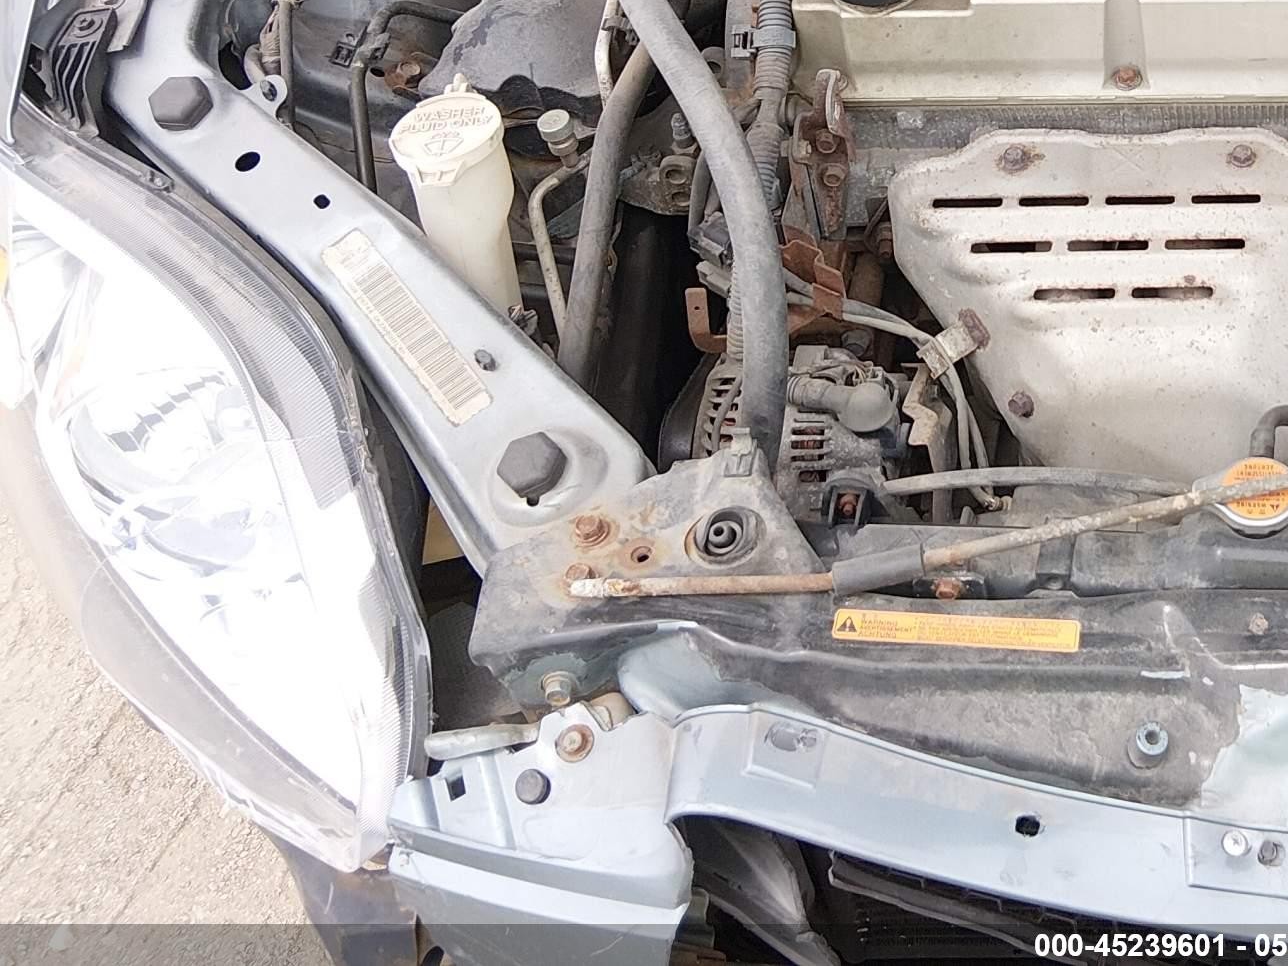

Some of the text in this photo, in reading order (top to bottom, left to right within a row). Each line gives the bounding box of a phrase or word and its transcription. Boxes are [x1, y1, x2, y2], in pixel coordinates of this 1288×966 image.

[414, 106, 486, 123] WASHER
[401, 115, 493, 134] FLUID ONLY
